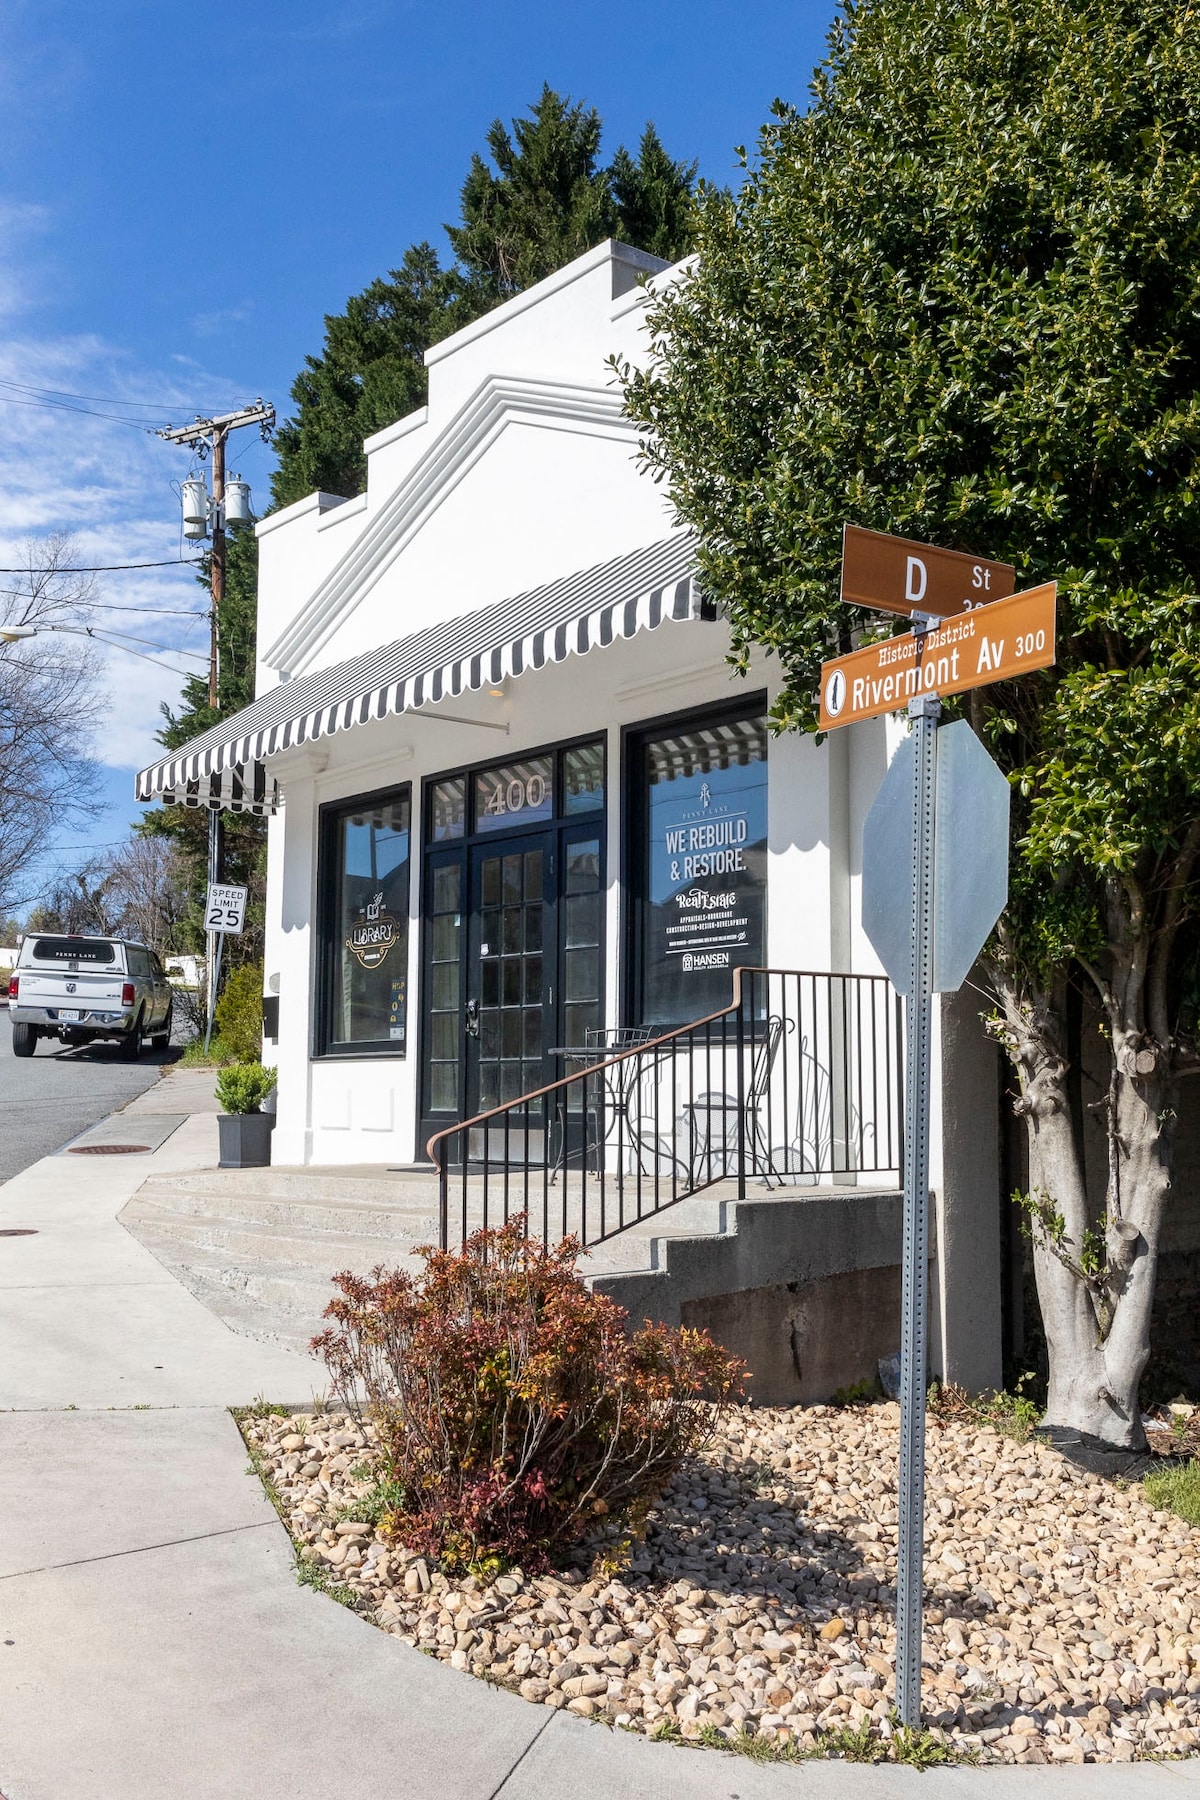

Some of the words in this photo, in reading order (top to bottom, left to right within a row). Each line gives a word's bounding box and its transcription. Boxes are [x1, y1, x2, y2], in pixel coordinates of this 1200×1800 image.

[905, 555, 928, 602] D
[971, 565, 991, 591] St
[878, 638, 924, 668] Historic
[926, 617, 976, 652] District
[852, 646, 960, 711] Rivermont
[976, 635, 1005, 674] Av
[1015, 629, 1045, 658] 300
[487, 774, 546, 816] 400
[682, 810, 706, 820] PENNY
[709, 805, 729, 815] LANE
[665, 829, 687, 855] WE
[689, 818, 747, 851] REBUILD
[670, 860, 681, 881] &
[684, 847, 747, 880] RESTORE.
[211, 888, 244, 900] SPEED
[214, 898, 239, 909] LIMIT
[675, 888, 704, 910] Real
[701, 891, 737, 911] Estate
[208, 908, 240, 927] 25
[353, 924, 393, 945] LIBRARY
[693, 952, 729, 966] HANSEN
